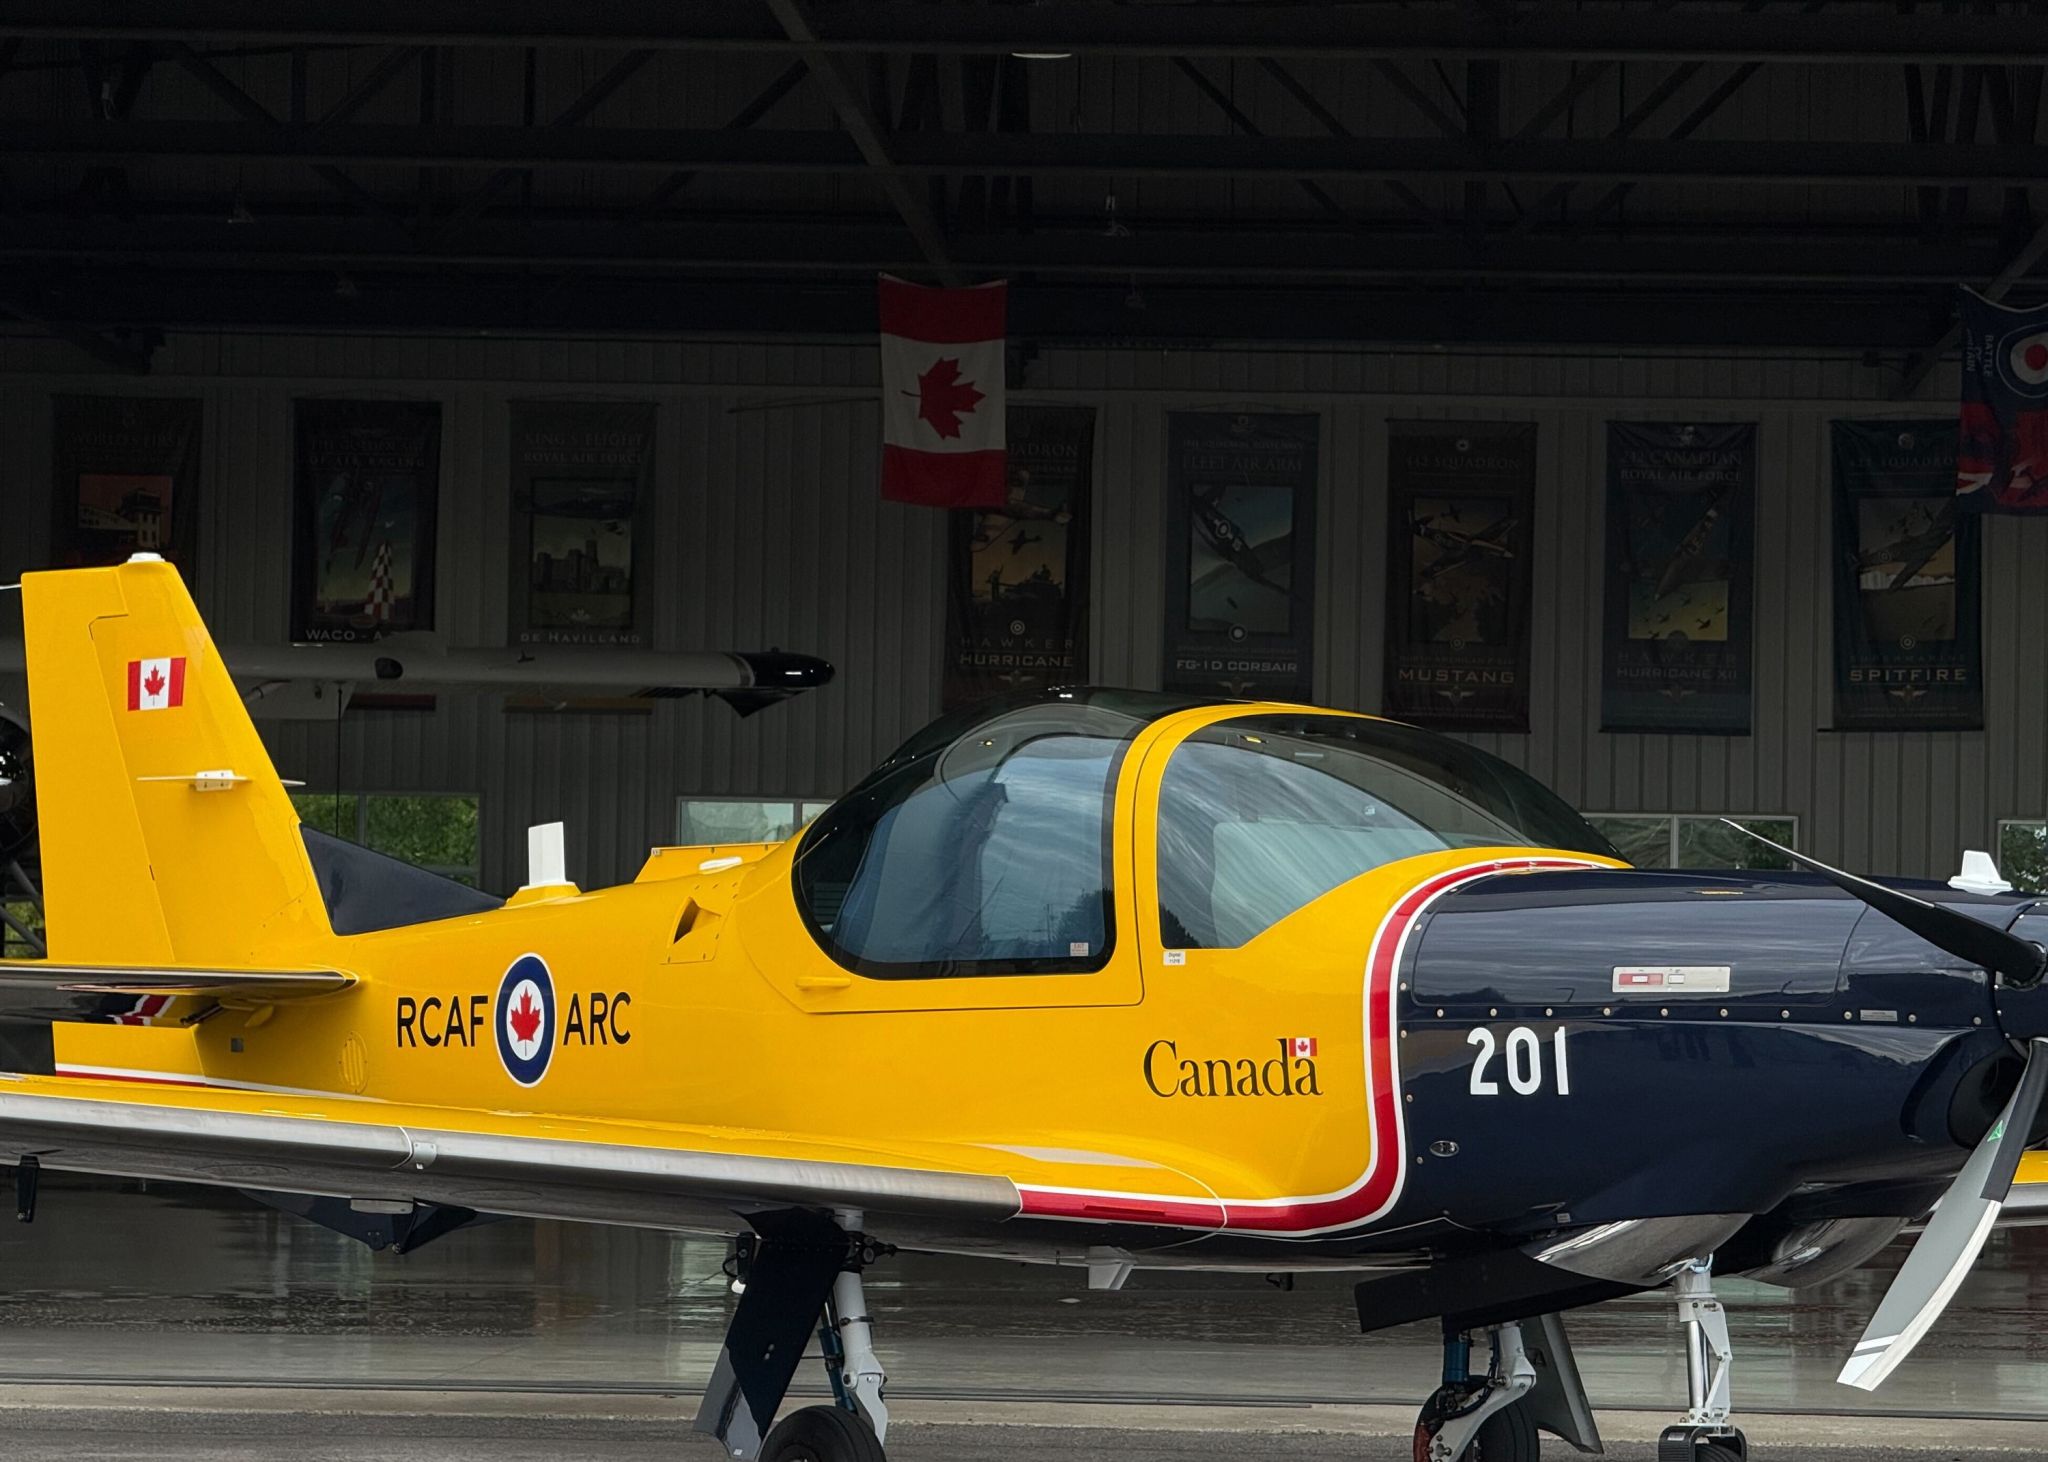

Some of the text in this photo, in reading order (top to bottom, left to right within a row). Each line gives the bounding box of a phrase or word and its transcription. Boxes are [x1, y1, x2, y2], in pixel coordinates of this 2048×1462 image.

[1881, 455, 1956, 469] SQUADRO
[1620, 468, 1664, 481] ROYAL
[1667, 469, 1694, 481] AIR
[305, 628, 356, 641] WACO
[519, 631, 641, 644] DE HAVILLAND
[960, 637, 1074, 649] HAWKER
[959, 653, 1074, 667] HURRICANE
[1227, 660, 1297, 673] CORSAIR
[1397, 668, 1515, 684] MUSTANG
[1616, 666, 1737, 680] HURRICANE XII
[1848, 668, 1967, 682] SPITFIRE
[396, 991, 632, 1048] RCAF ARC
[1143, 1037, 1324, 1098] Canada
[1466, 1026, 1570, 1096] 201
